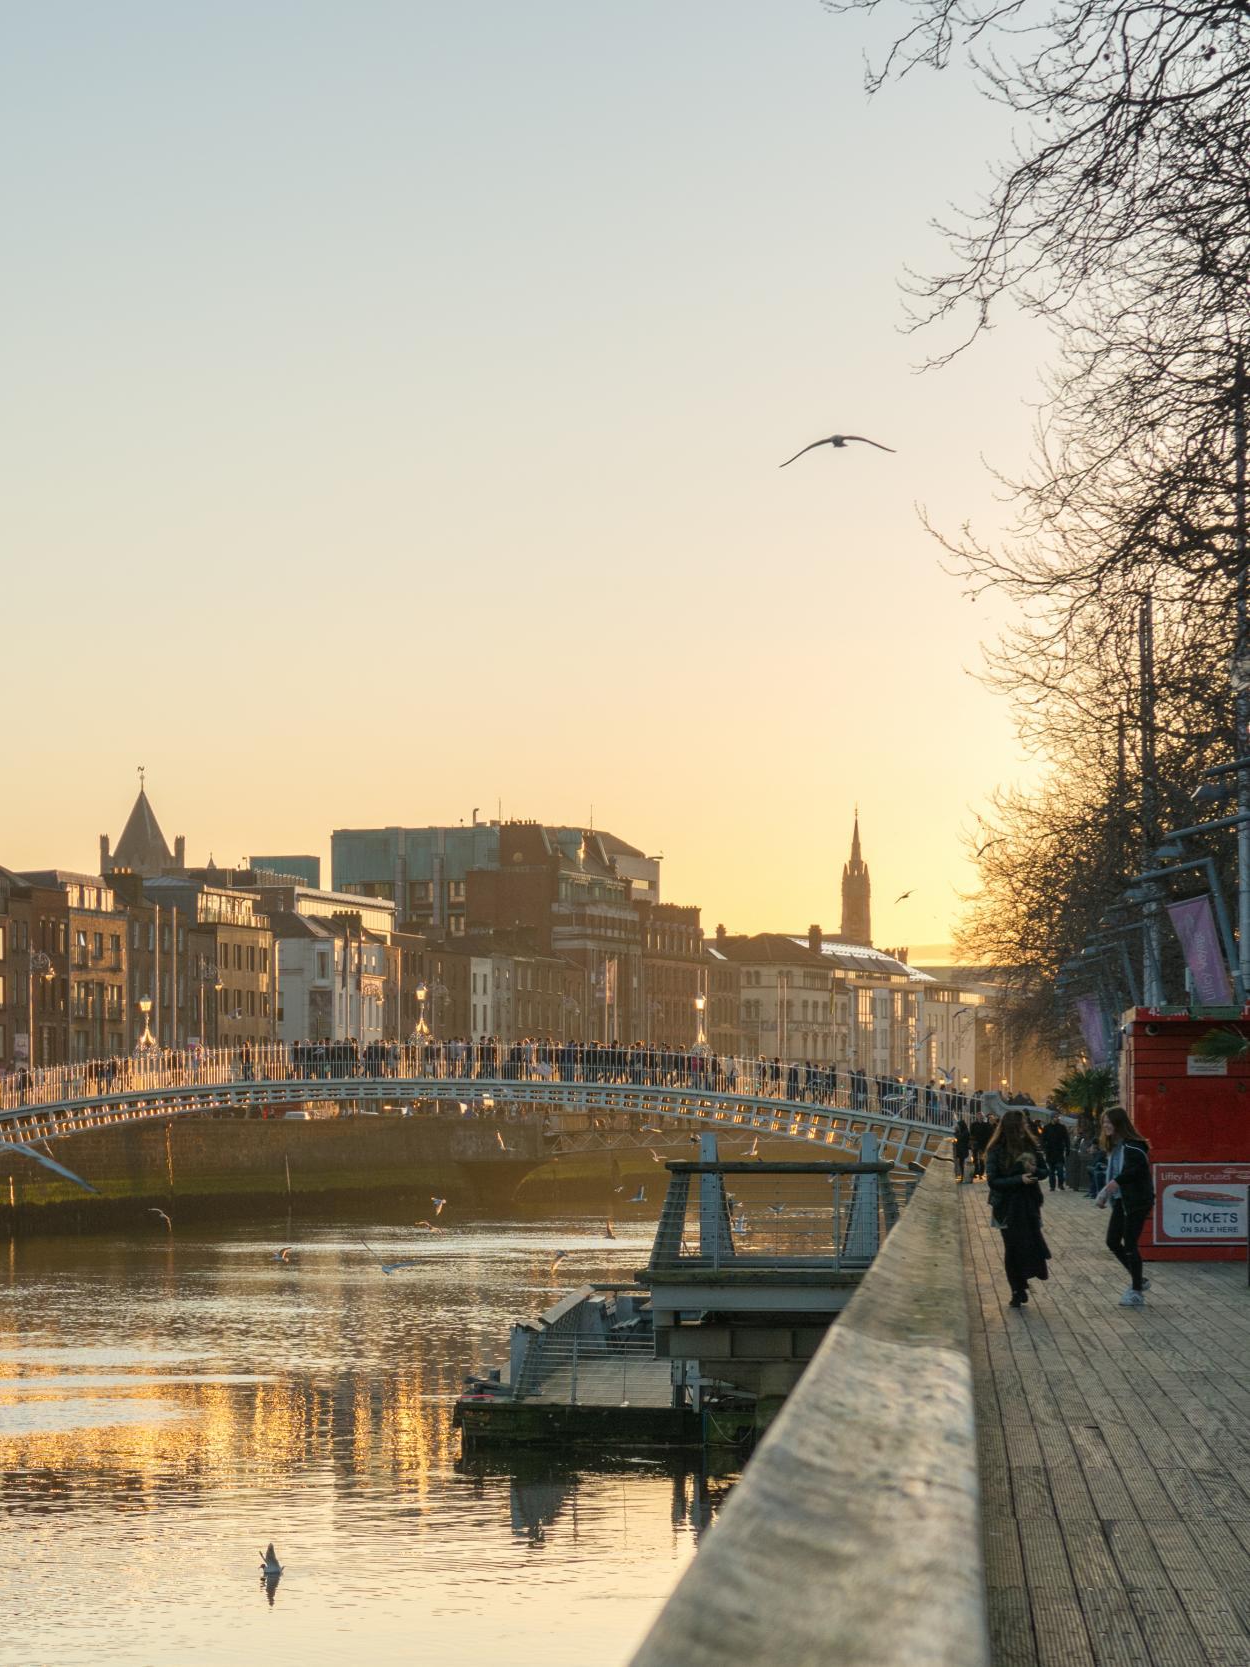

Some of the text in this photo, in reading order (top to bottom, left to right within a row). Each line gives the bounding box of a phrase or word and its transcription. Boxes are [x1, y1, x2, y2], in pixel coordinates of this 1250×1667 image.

[1161, 1172, 1183, 1182] Liffey
[1183, 1172, 1203, 1181] River
[1181, 1212, 1239, 1224] TICKETS
